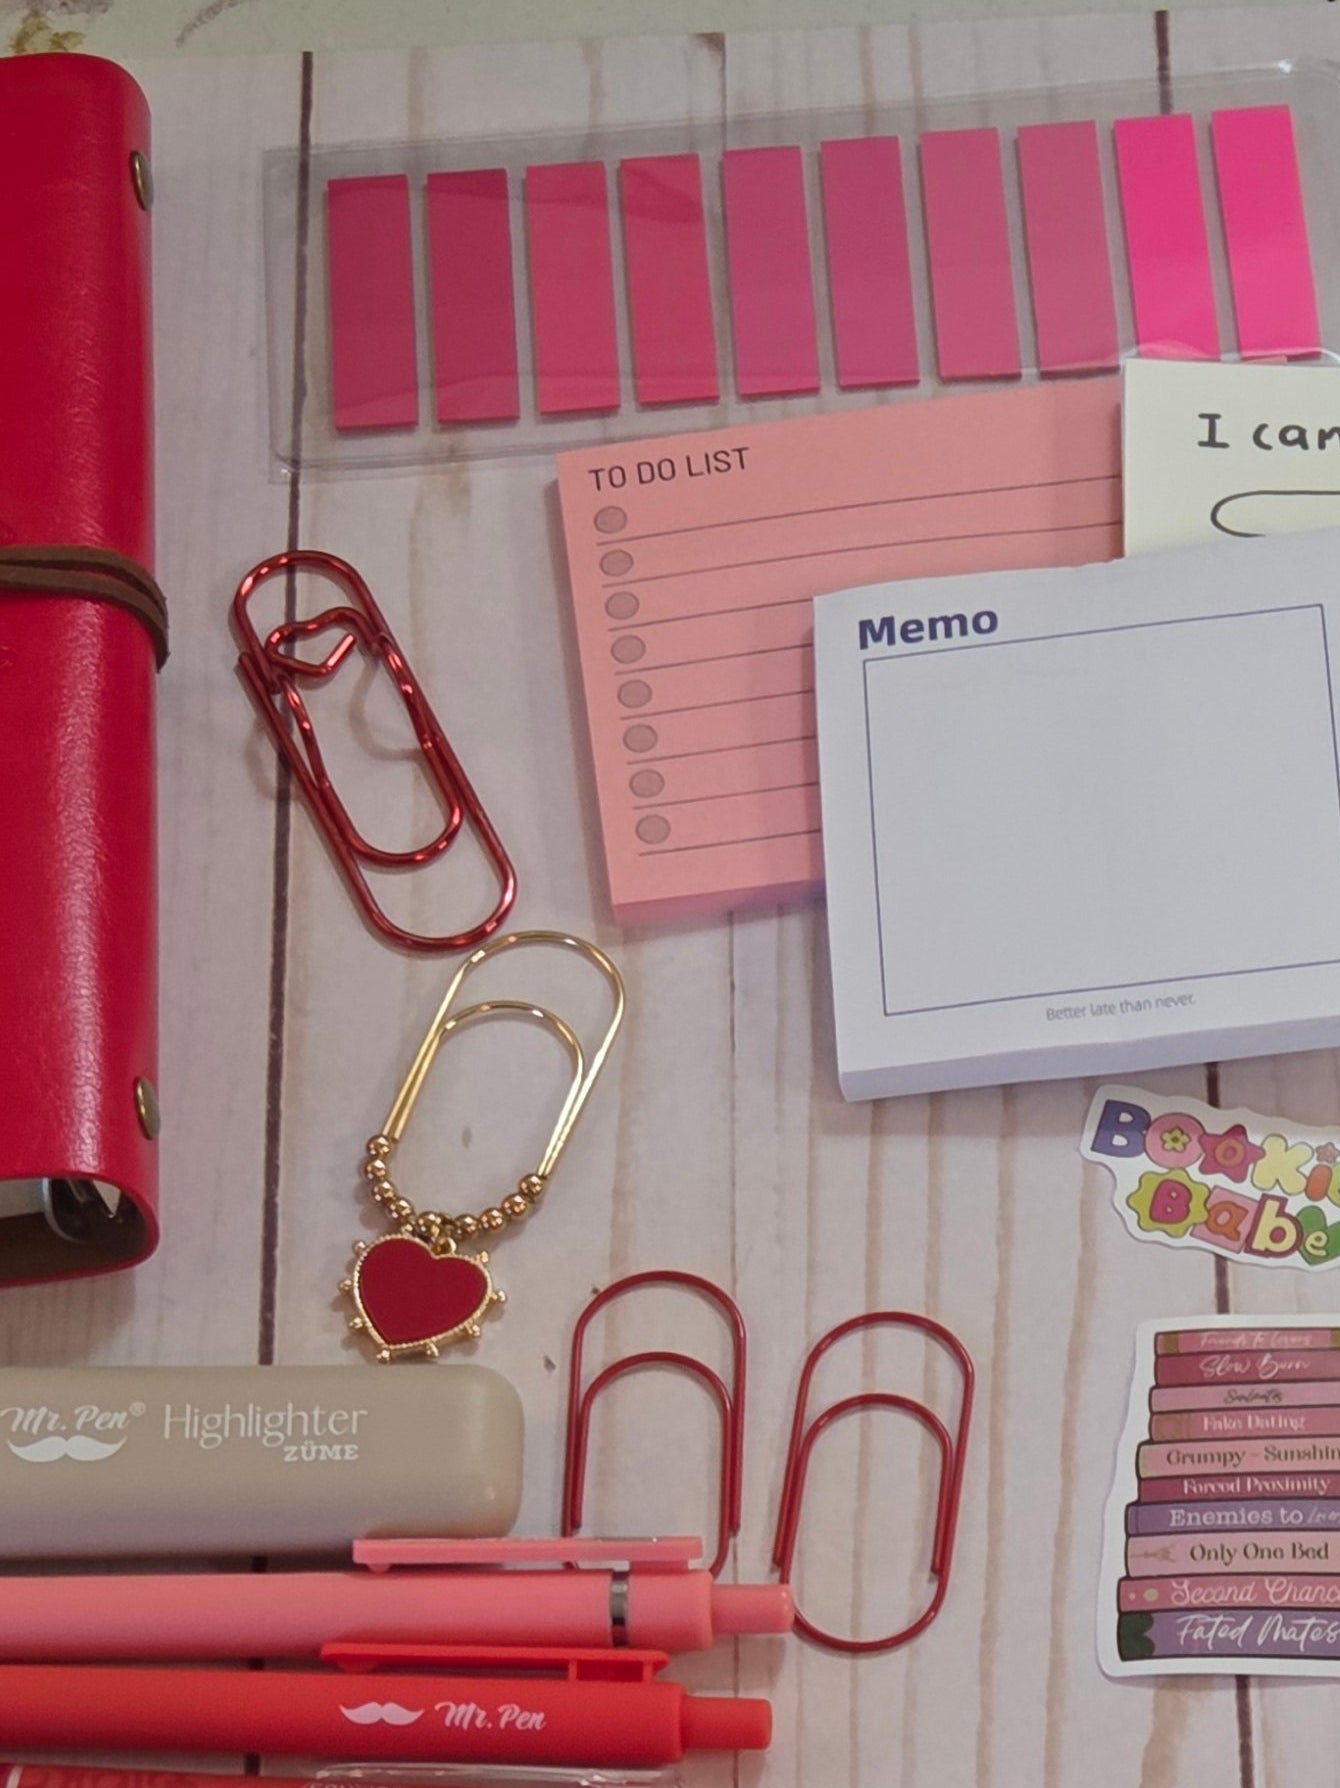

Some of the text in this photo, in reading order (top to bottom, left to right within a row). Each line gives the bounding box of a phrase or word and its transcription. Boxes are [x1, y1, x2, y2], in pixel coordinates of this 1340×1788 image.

[1197, 412, 1230, 450] I
[588, 446, 751, 493] TO DO LIST
[857, 609, 999, 650] Memo
[1046, 1003, 1087, 1022] Better
[1089, 1001, 1117, 1019] late
[1119, 997, 1152, 1016] than
[1199, 1354, 1251, 1378] Slow
[0, 1406, 67, 1435] Mr.
[163, 1402, 368, 1449] Highlighter
[1203, 1414, 1306, 1434] Fake Dating
[283, 1440, 359, 1462] ZÜME
[1166, 1448, 1246, 1472] Grumpy
[1183, 1476, 1331, 1496] Forced Proximity
[1169, 1507, 1273, 1528] Enemies
[1279, 1507, 1304, 1525] to
[1189, 1543, 1330, 1566] Only One Bed
[1171, 1578, 1256, 1606] Second
[1176, 1615, 1253, 1650] Fated
[434, 1702, 546, 1730] Mr. Pen
